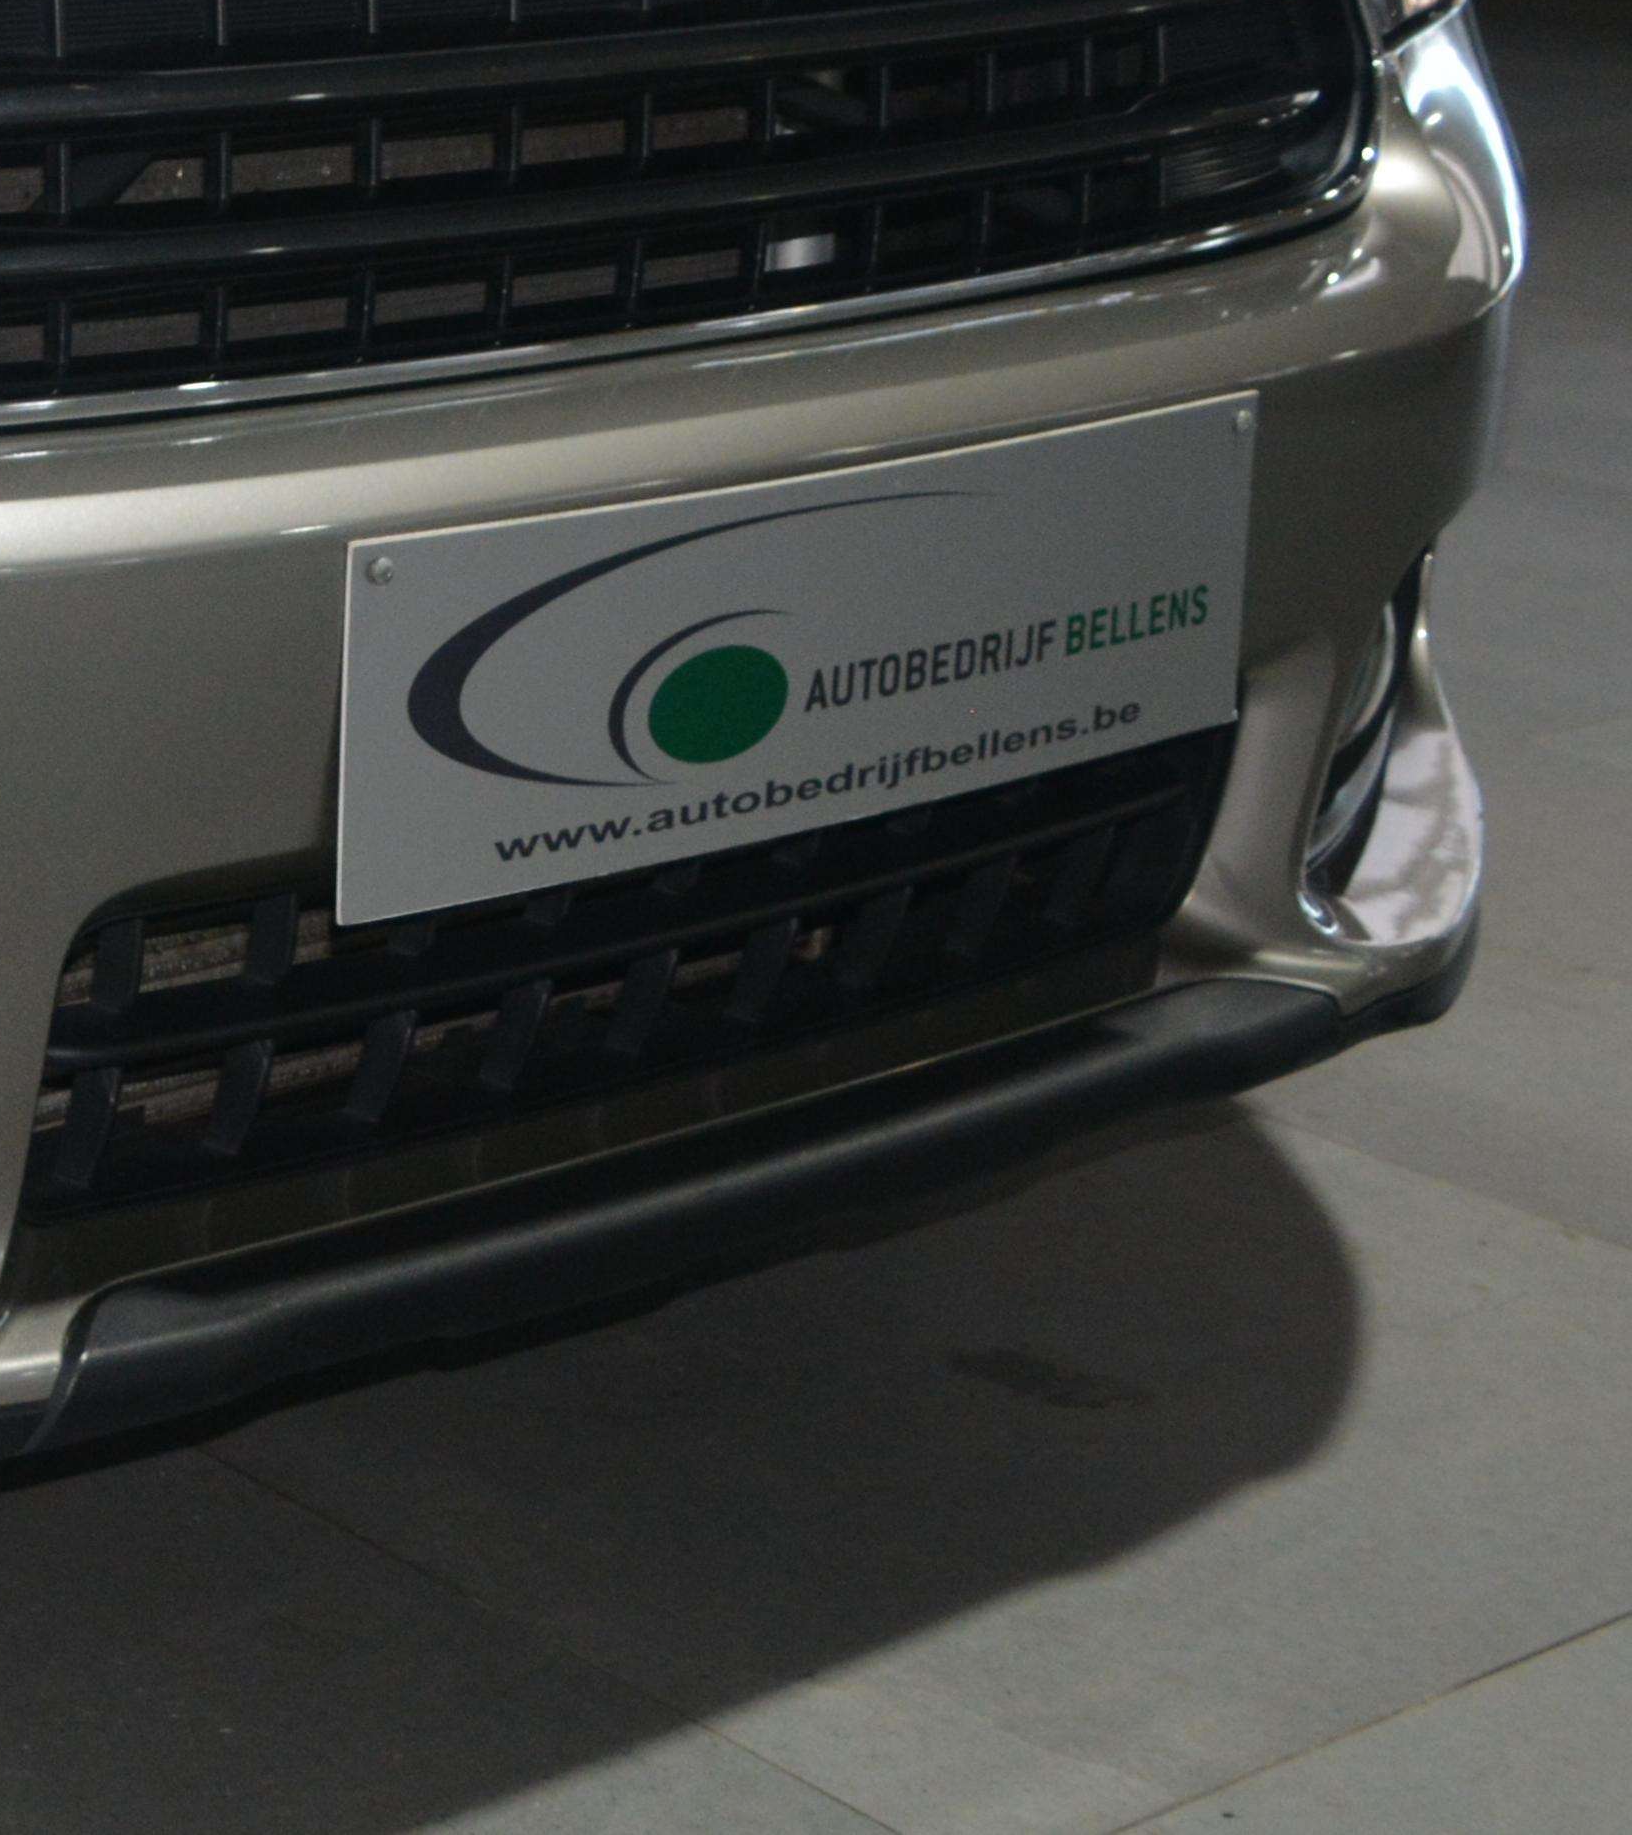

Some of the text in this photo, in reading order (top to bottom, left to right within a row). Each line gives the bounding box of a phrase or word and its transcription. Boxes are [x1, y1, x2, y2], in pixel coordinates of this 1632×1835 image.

[803, 584, 1209, 713] AUTOBEDRIJF BELLENS
[494, 701, 1141, 863] www.autobedrijfbellens.be
